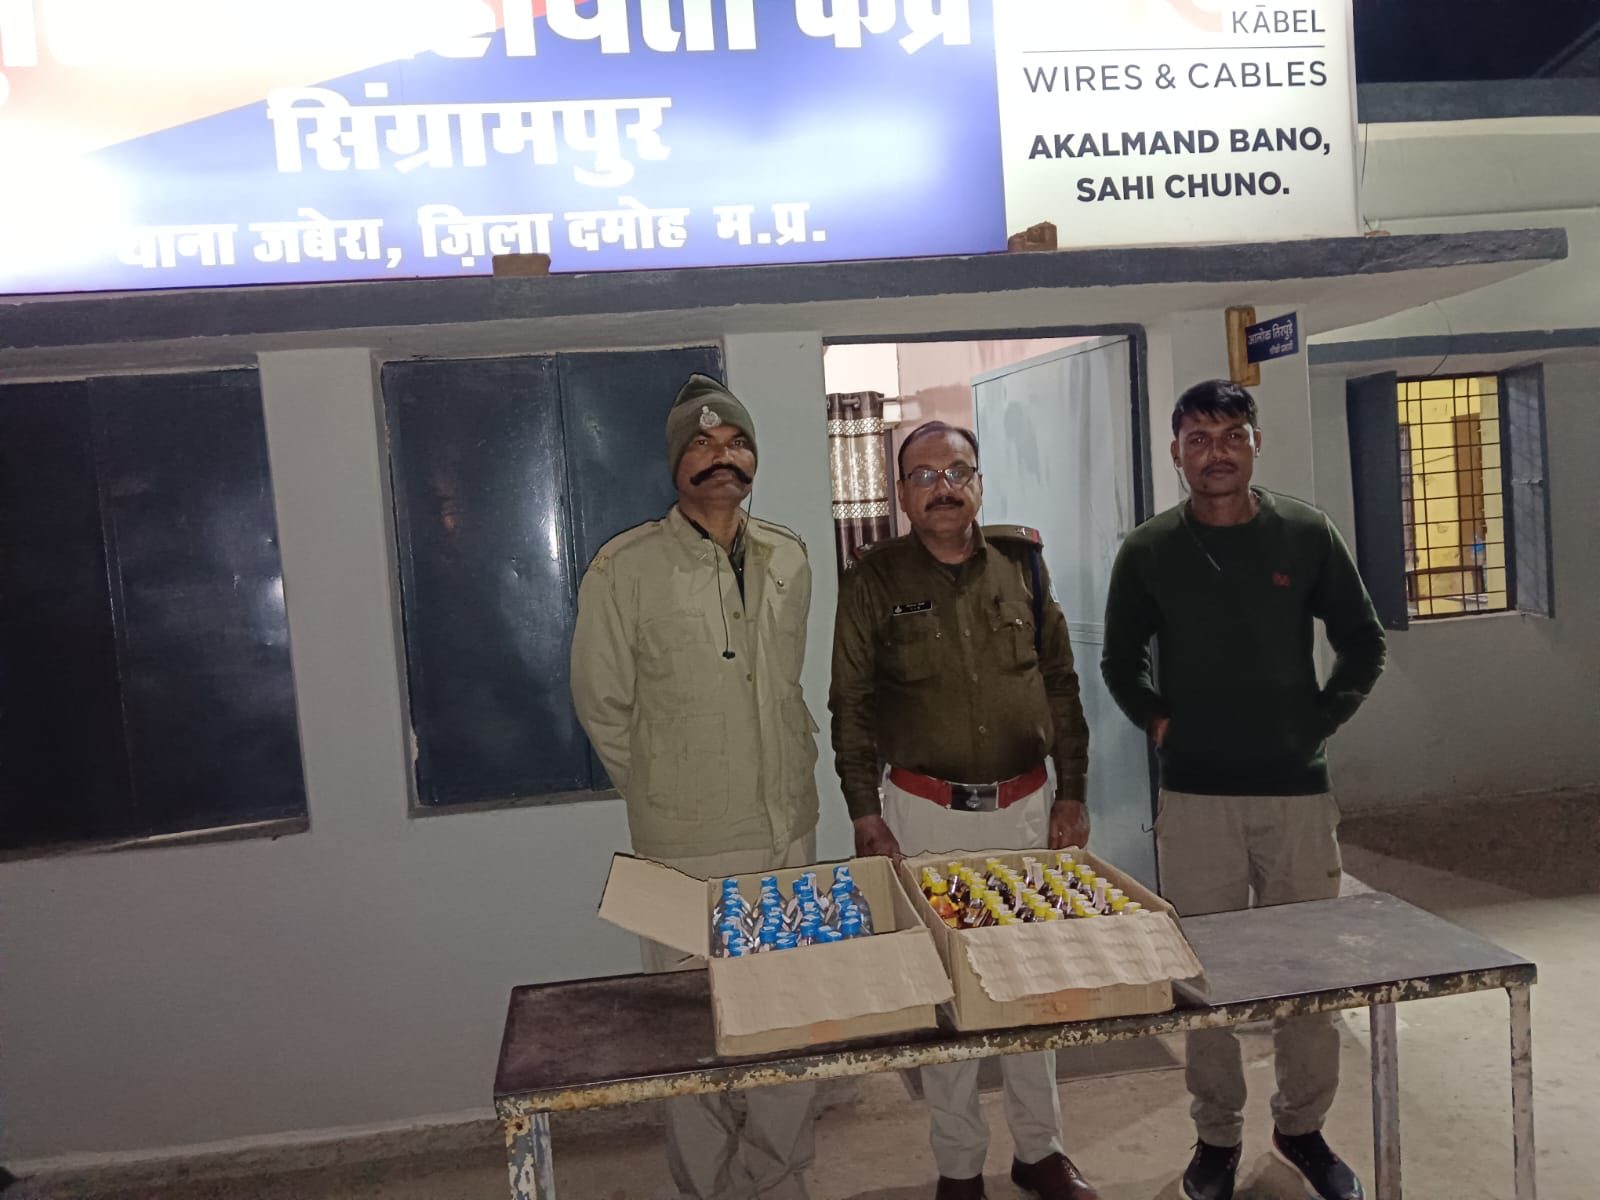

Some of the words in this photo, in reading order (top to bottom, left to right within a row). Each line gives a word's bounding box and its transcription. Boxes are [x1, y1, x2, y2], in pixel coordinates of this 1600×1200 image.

[1023, 63, 1142, 93] WIRES
[1155, 63, 1176, 89] &
[1188, 60, 1327, 89] CABLES
[267, 83, 671, 187] सिंग्रामपुर
[1028, 130, 1219, 159] AKALMAND
[1230, 127, 1331, 155] BANO,
[1077, 174, 1153, 202] SAHI
[1165, 171, 1290, 198] CHUNO.
[249, 209, 402, 268] जबेरा,
[566, 197, 690, 251] दमोह
[714, 203, 827, 246] म.प्र.
